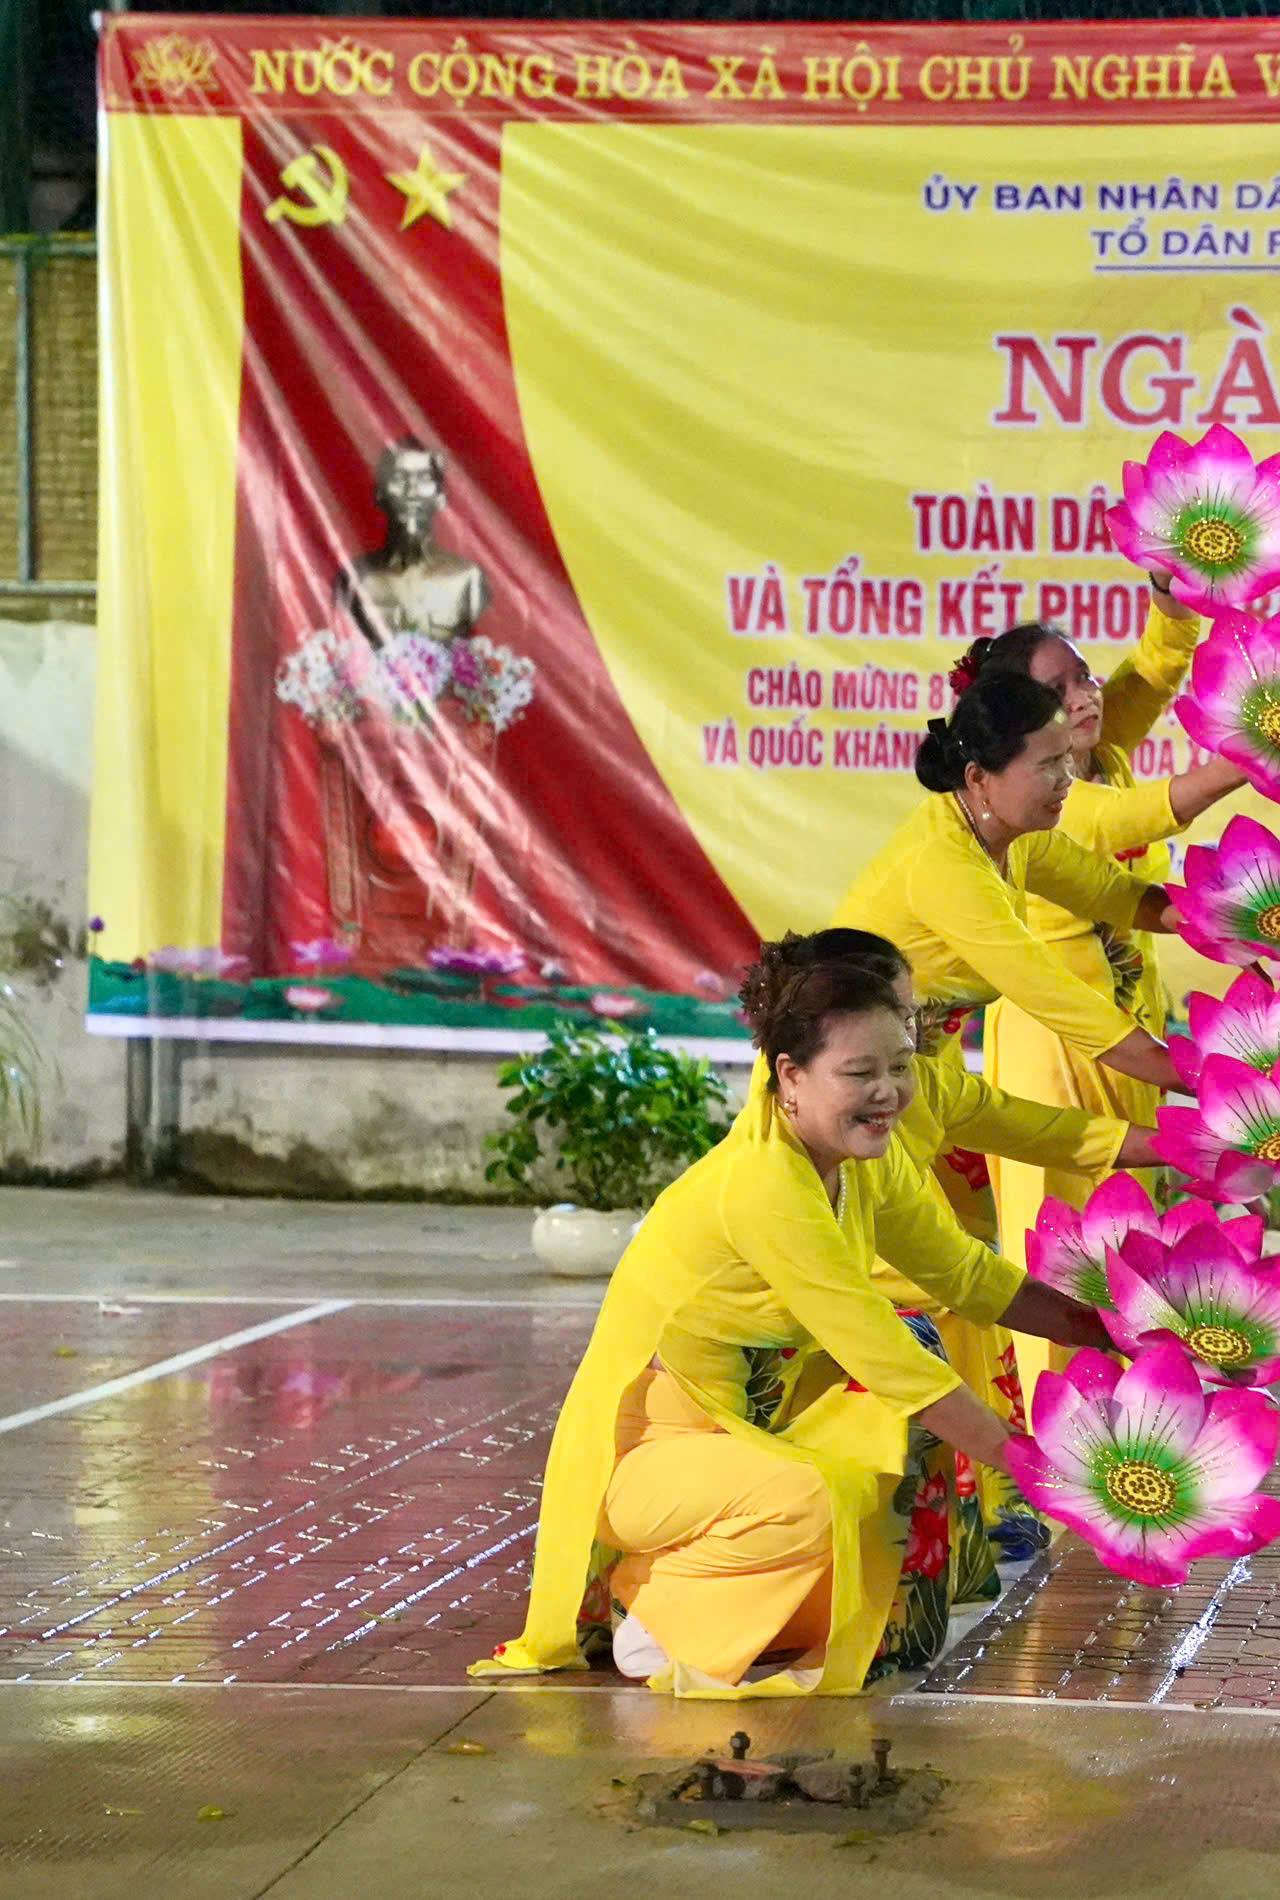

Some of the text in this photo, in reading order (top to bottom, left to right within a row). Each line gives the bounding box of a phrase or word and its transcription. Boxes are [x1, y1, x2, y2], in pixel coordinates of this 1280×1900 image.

[250, 37, 394, 96] NƯỚC
[408, 38, 557, 107] CỘNG
[573, 41, 690, 100] HÒA
[706, 47, 786, 100] XÃ
[804, 41, 902, 111] HỘI
[919, 33, 1031, 99] CHỦ
[1050, 42, 1237, 99] NGHĨA
[925, 172, 977, 212] ỦY
[994, 183, 1081, 211] BAN
[1098, 174, 1220, 211] NHÂN
[1092, 217, 1149, 257] TỔ
[1163, 221, 1250, 256] DÂN
[913, 483, 1034, 552] TOÀN
[1051, 485, 1126, 553] DÂ
[728, 565, 787, 634] VÀ
[802, 558, 923, 636] TỔNG
[940, 563, 1024, 637] KẾT
[1040, 583, 1152, 641] PHO
[748, 661, 824, 709] CHÀO
[832, 660, 918, 710] MỪNG
[703, 717, 739, 765] VÀ
[750, 713, 825, 770] QUỐC
